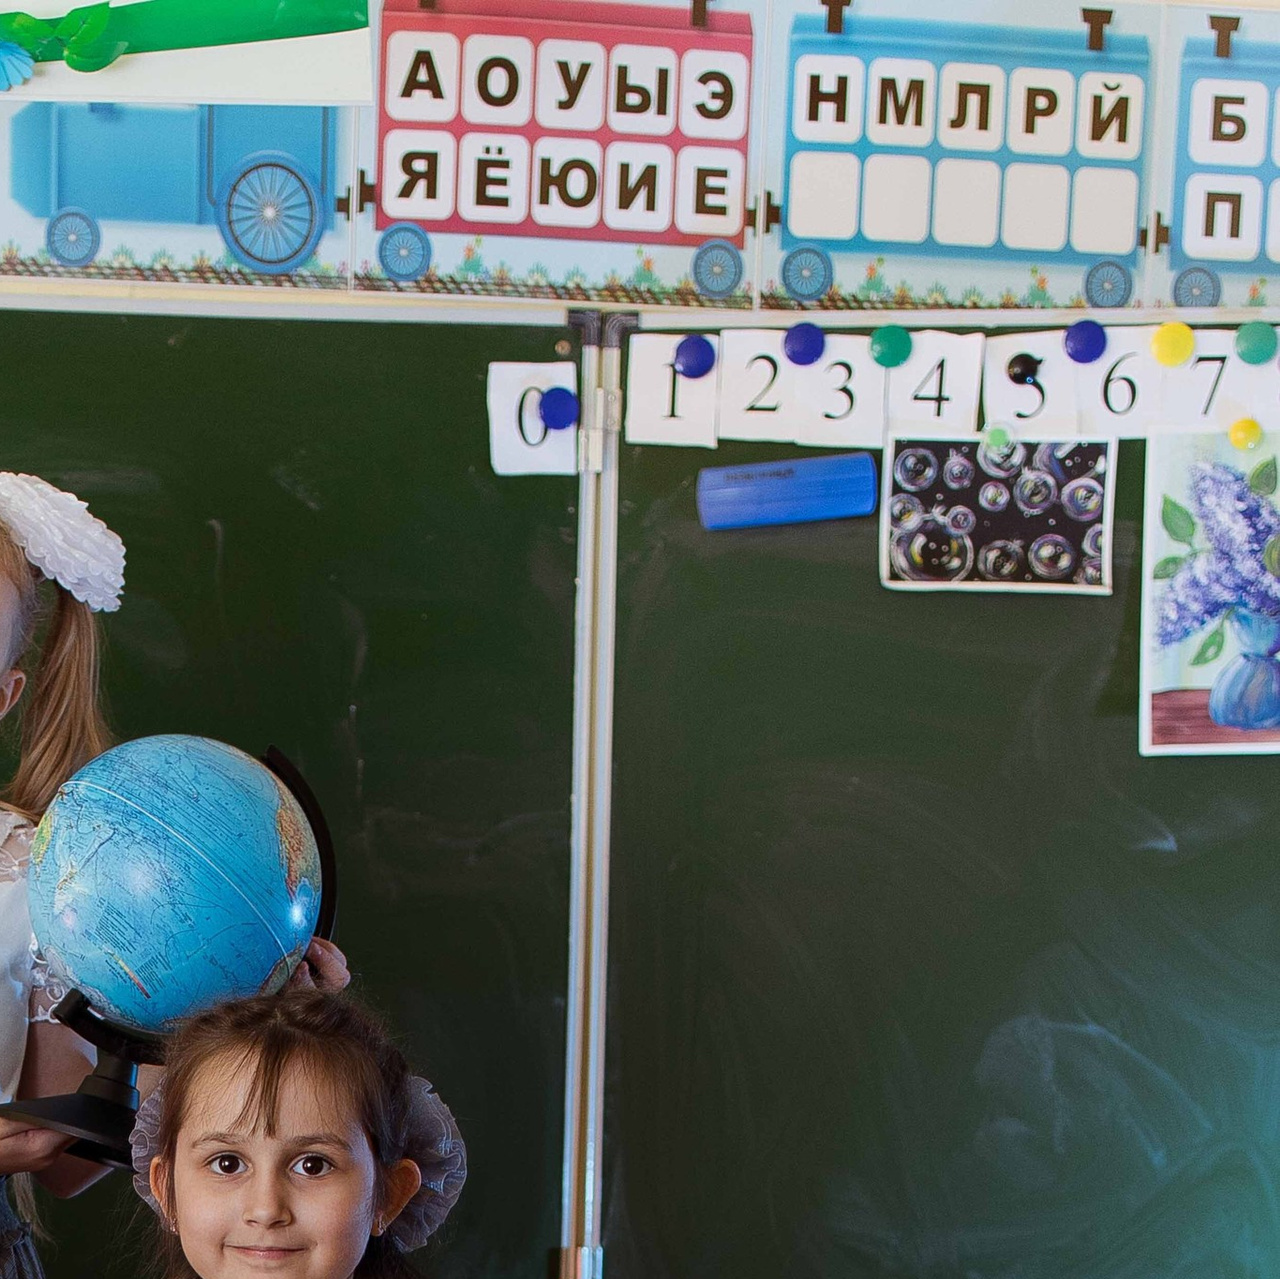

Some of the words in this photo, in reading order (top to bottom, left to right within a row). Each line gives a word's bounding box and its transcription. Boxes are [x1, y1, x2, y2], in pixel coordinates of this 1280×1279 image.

[1211, 95, 1246, 142] Б
[1204, 192, 1242, 238] П
[659, 362, 680, 419] 1
[744, 354, 781, 412] 2
[823, 361, 855, 420] 3
[913, 358, 951, 417] 4
[1102, 351, 1138, 416] 6
[1190, 355, 1227, 416] 7
[517, 386, 548, 446] 0
